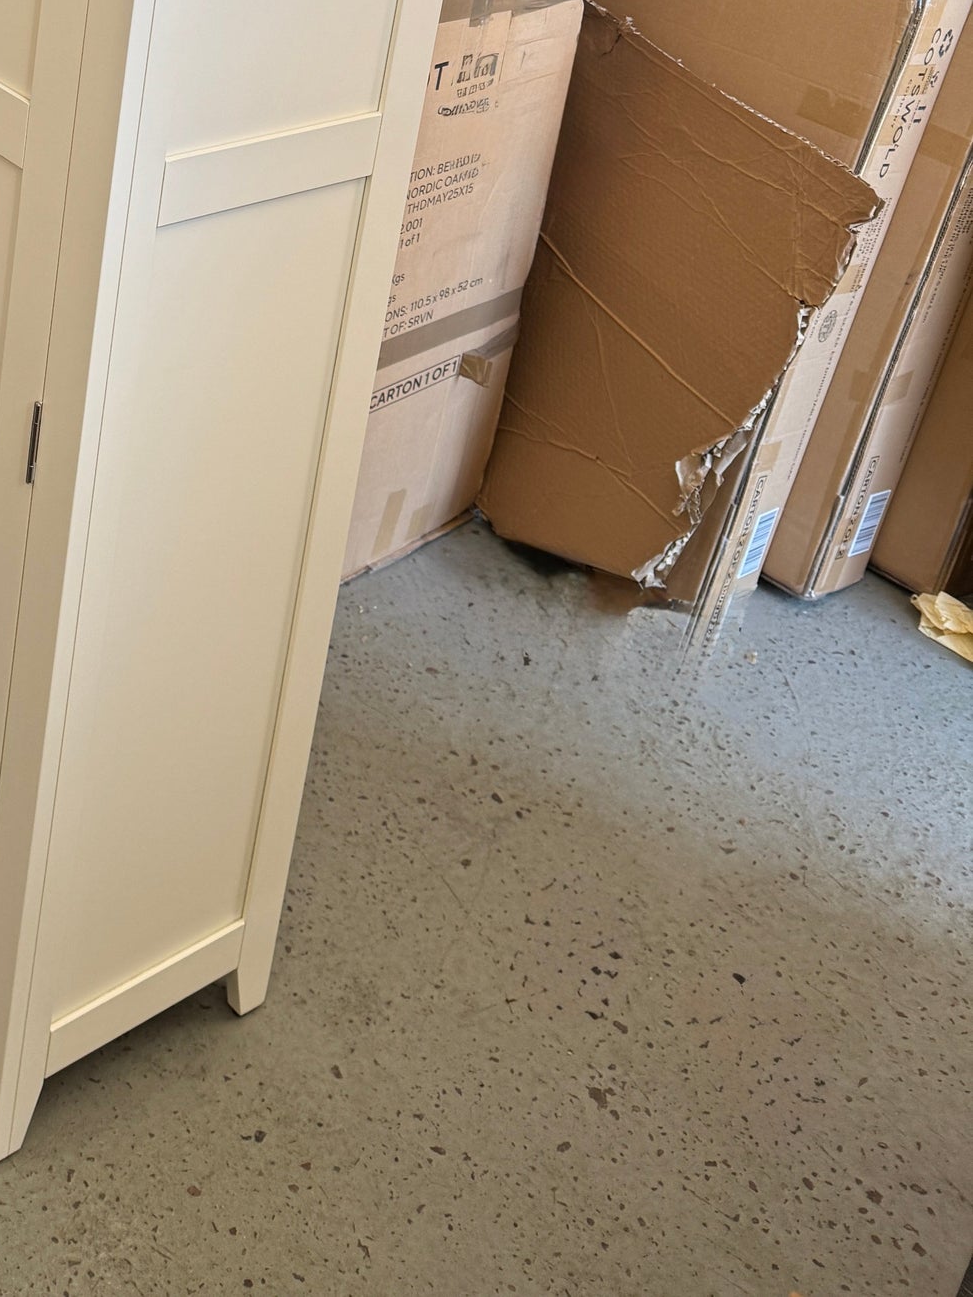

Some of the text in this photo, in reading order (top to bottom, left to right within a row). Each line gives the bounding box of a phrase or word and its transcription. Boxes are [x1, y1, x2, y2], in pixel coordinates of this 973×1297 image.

[880, 28, 942, 178] COTSWOLD
[405, 235, 416, 247] of
[416, 233, 421, 243] 1
[410, 295, 432, 313] 110.5
[432, 294, 438, 304] x
[439, 286, 451, 301] 98
[451, 286, 457, 296] x
[457, 279, 469, 294] 52
[470, 276, 484, 288] cm
[390, 321, 407, 336] OF:
[408, 310, 435, 329] SRVN
[369, 359, 458, 410] CARTON 1 OF 1
[741, 478, 767, 538] CARTON
[853, 458, 880, 519] CARTON
